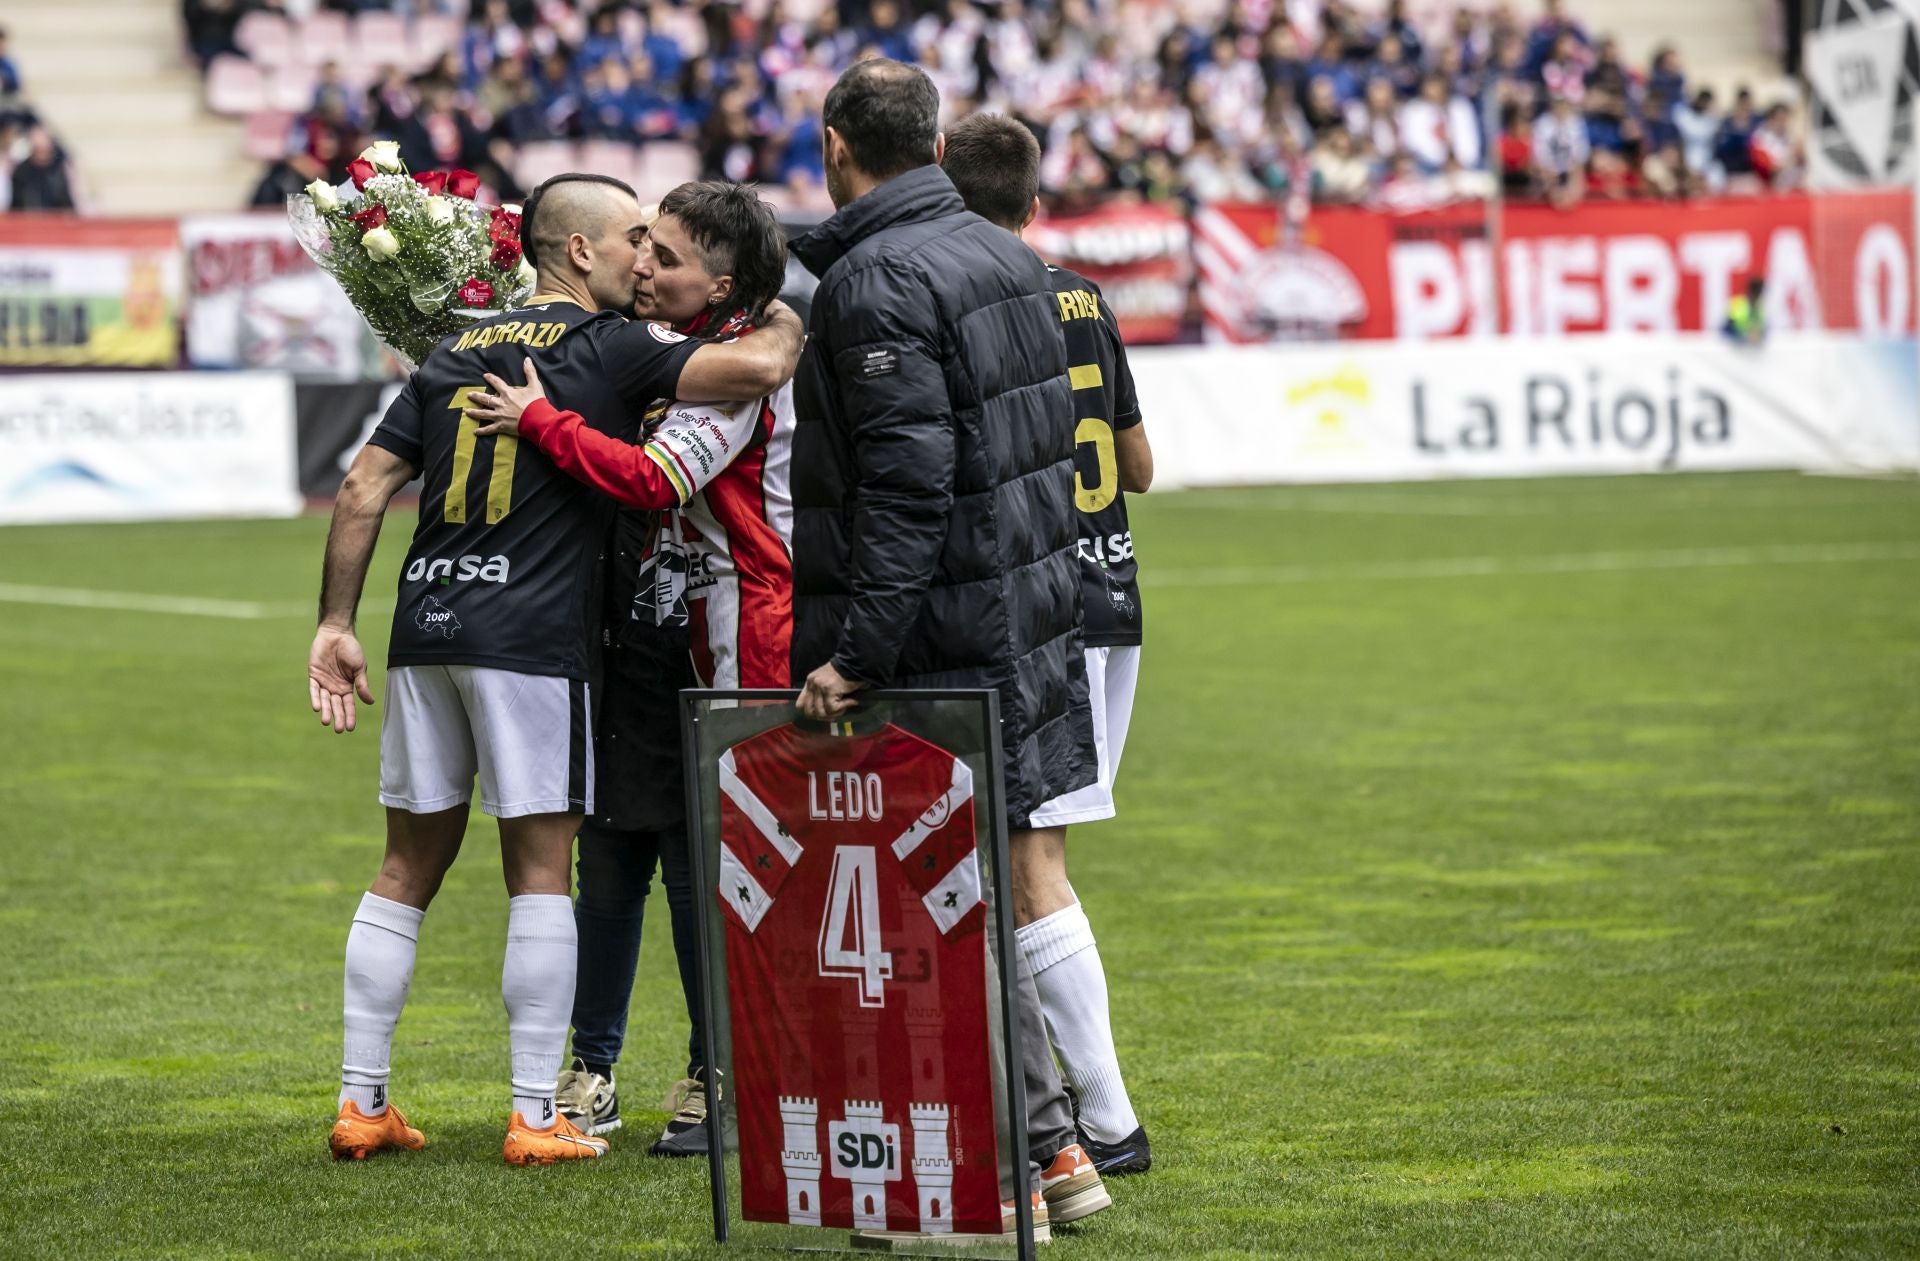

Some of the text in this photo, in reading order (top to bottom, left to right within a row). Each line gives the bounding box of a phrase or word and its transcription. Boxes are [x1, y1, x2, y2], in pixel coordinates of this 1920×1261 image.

[1389, 226, 1820, 341] PUERTA
[450, 321, 567, 352] MADRAZO
[1412, 367, 1732, 468] La Rioja
[444, 385, 527, 525] 11
[681, 436, 692, 446] de
[691, 445, 700, 457] La
[688, 429, 715, 463] Gobierno
[425, 613, 450, 622] 2009
[808, 771, 883, 822] LEDO
[817, 845, 893, 1008] 4
[837, 1131, 895, 1170] SDi
